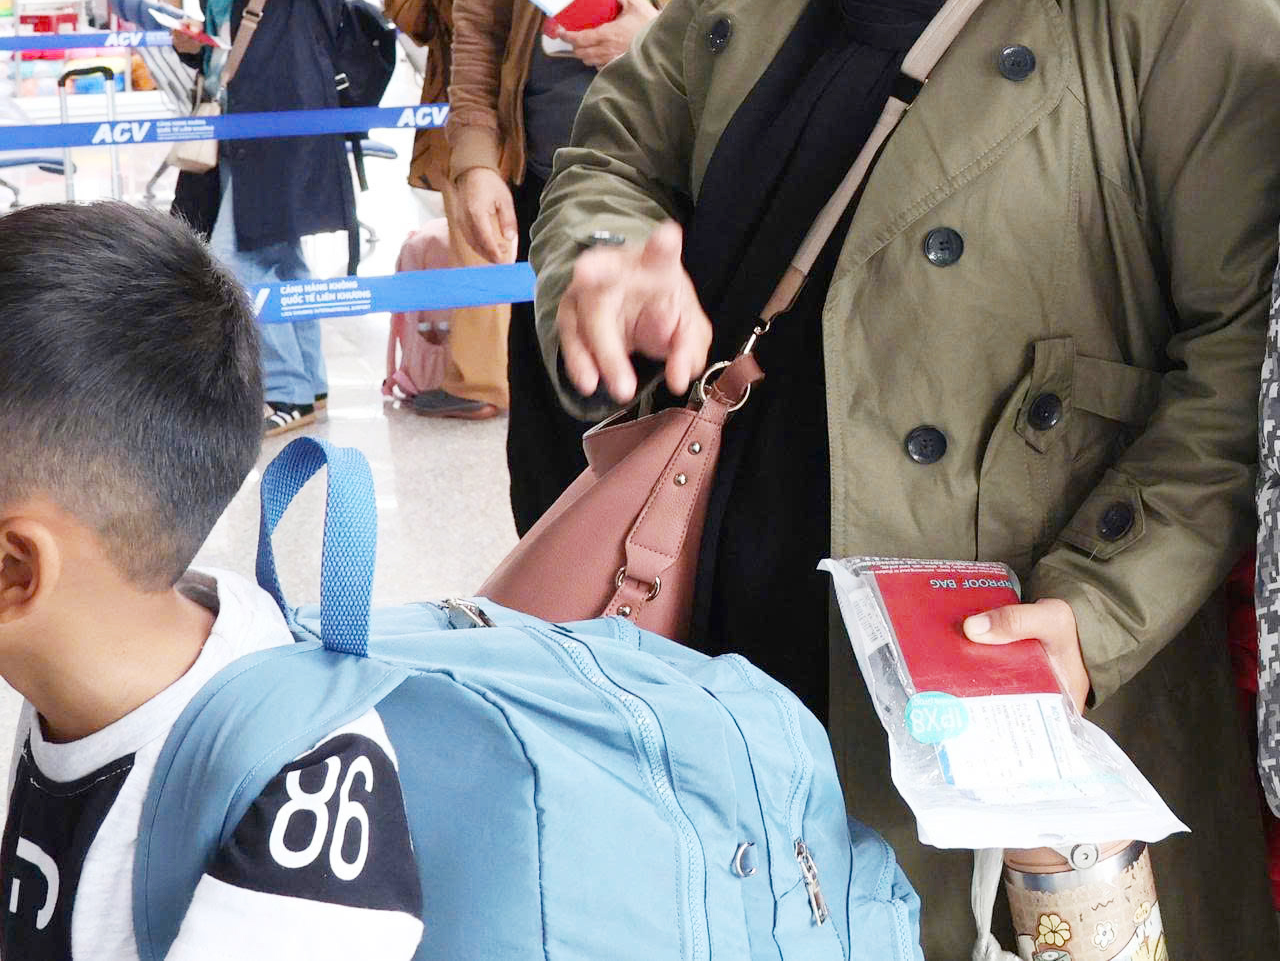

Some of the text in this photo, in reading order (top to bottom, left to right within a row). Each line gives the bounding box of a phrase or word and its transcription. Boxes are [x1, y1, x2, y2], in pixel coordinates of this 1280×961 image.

[104, 32, 143, 47] ACV
[397, 107, 450, 127] ACV
[91, 121, 151, 144] ACV
[930, 579, 957, 589] BAG
[268, 755, 375, 881] 86
